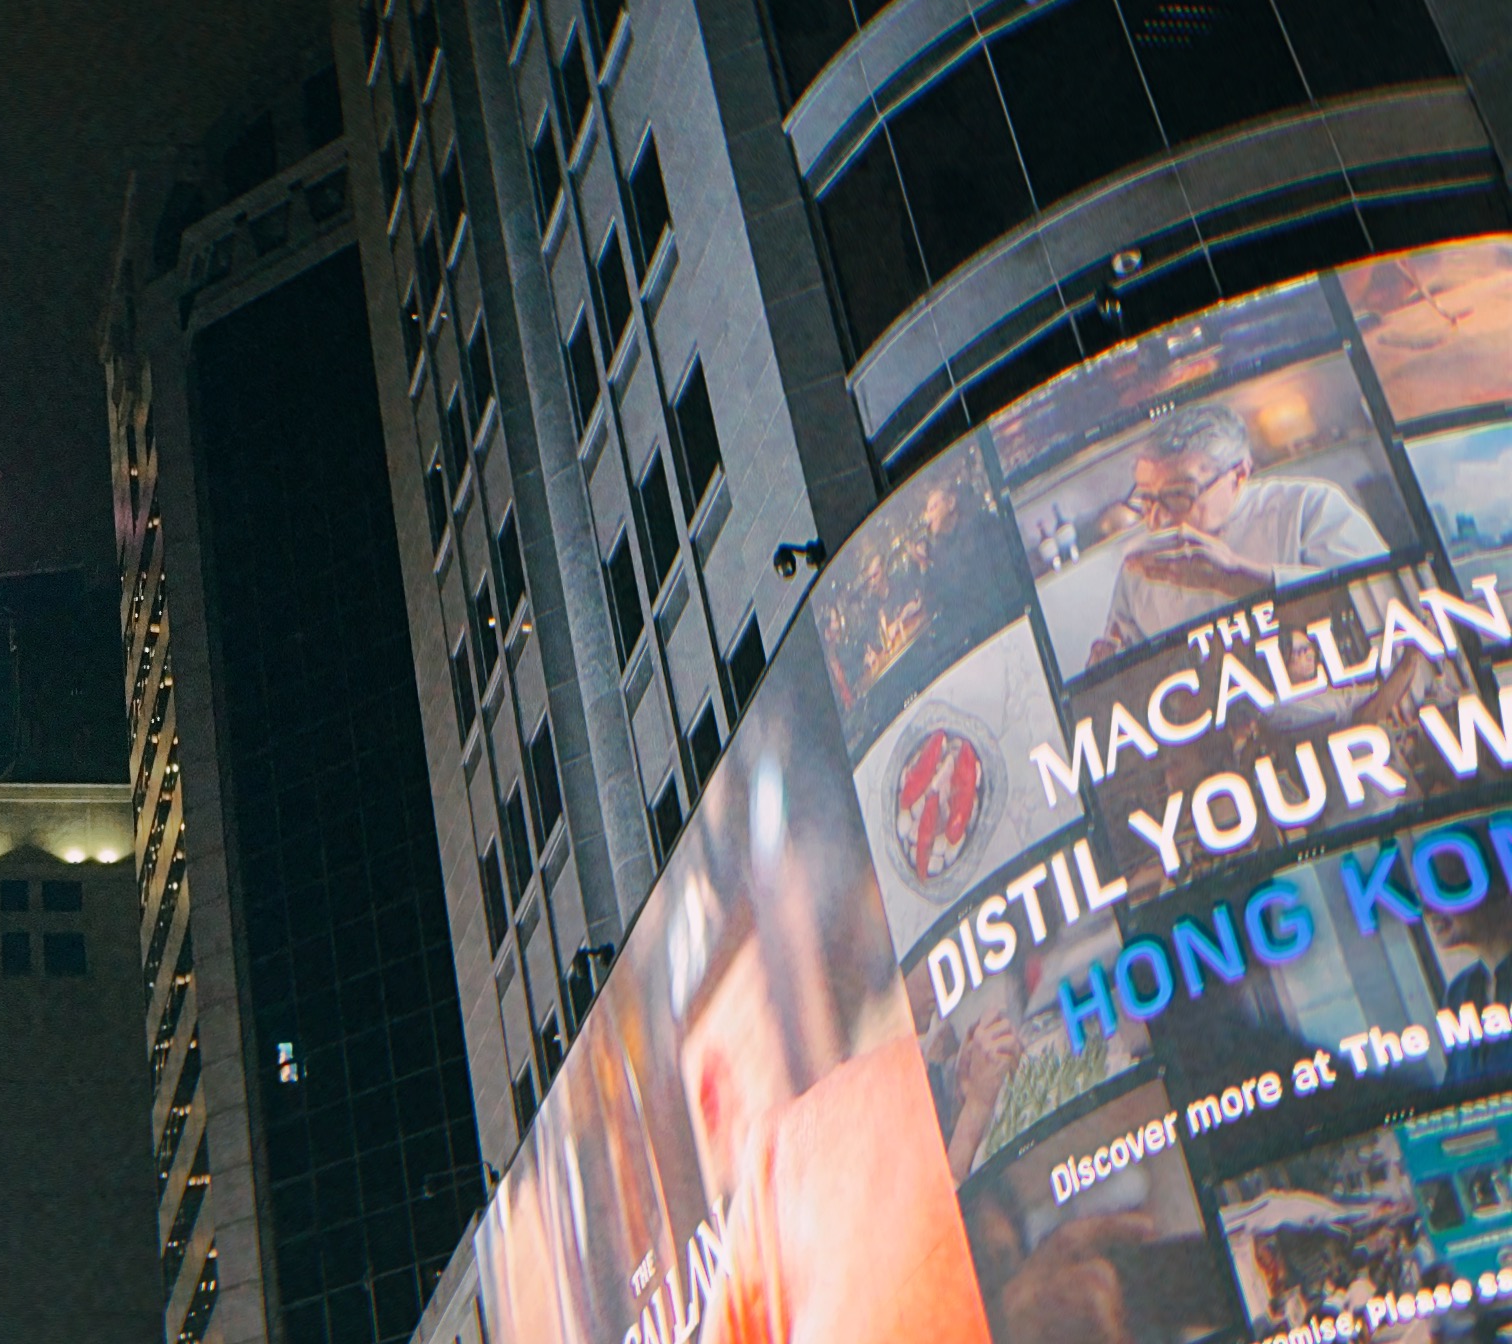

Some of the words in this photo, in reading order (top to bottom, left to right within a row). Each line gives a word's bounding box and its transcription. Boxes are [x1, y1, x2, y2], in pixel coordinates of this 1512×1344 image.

[1030, 574, 1512, 808] MACALLAN
[1188, 601, 1278, 659] THE
[928, 838, 1128, 1018] DISTIL
[1129, 725, 1406, 875] YOUR
[1058, 879, 1314, 1052] HONG
[1051, 1108, 1178, 1206] Discover
[1187, 1071, 1282, 1138] more
[1293, 1050, 1336, 1092] at
[1340, 1025, 1429, 1078] The
[1437, 1001, 1512, 1048] Ma
[630, 1249, 656, 1298] THE
[1366, 1278, 1473, 1330] Please
